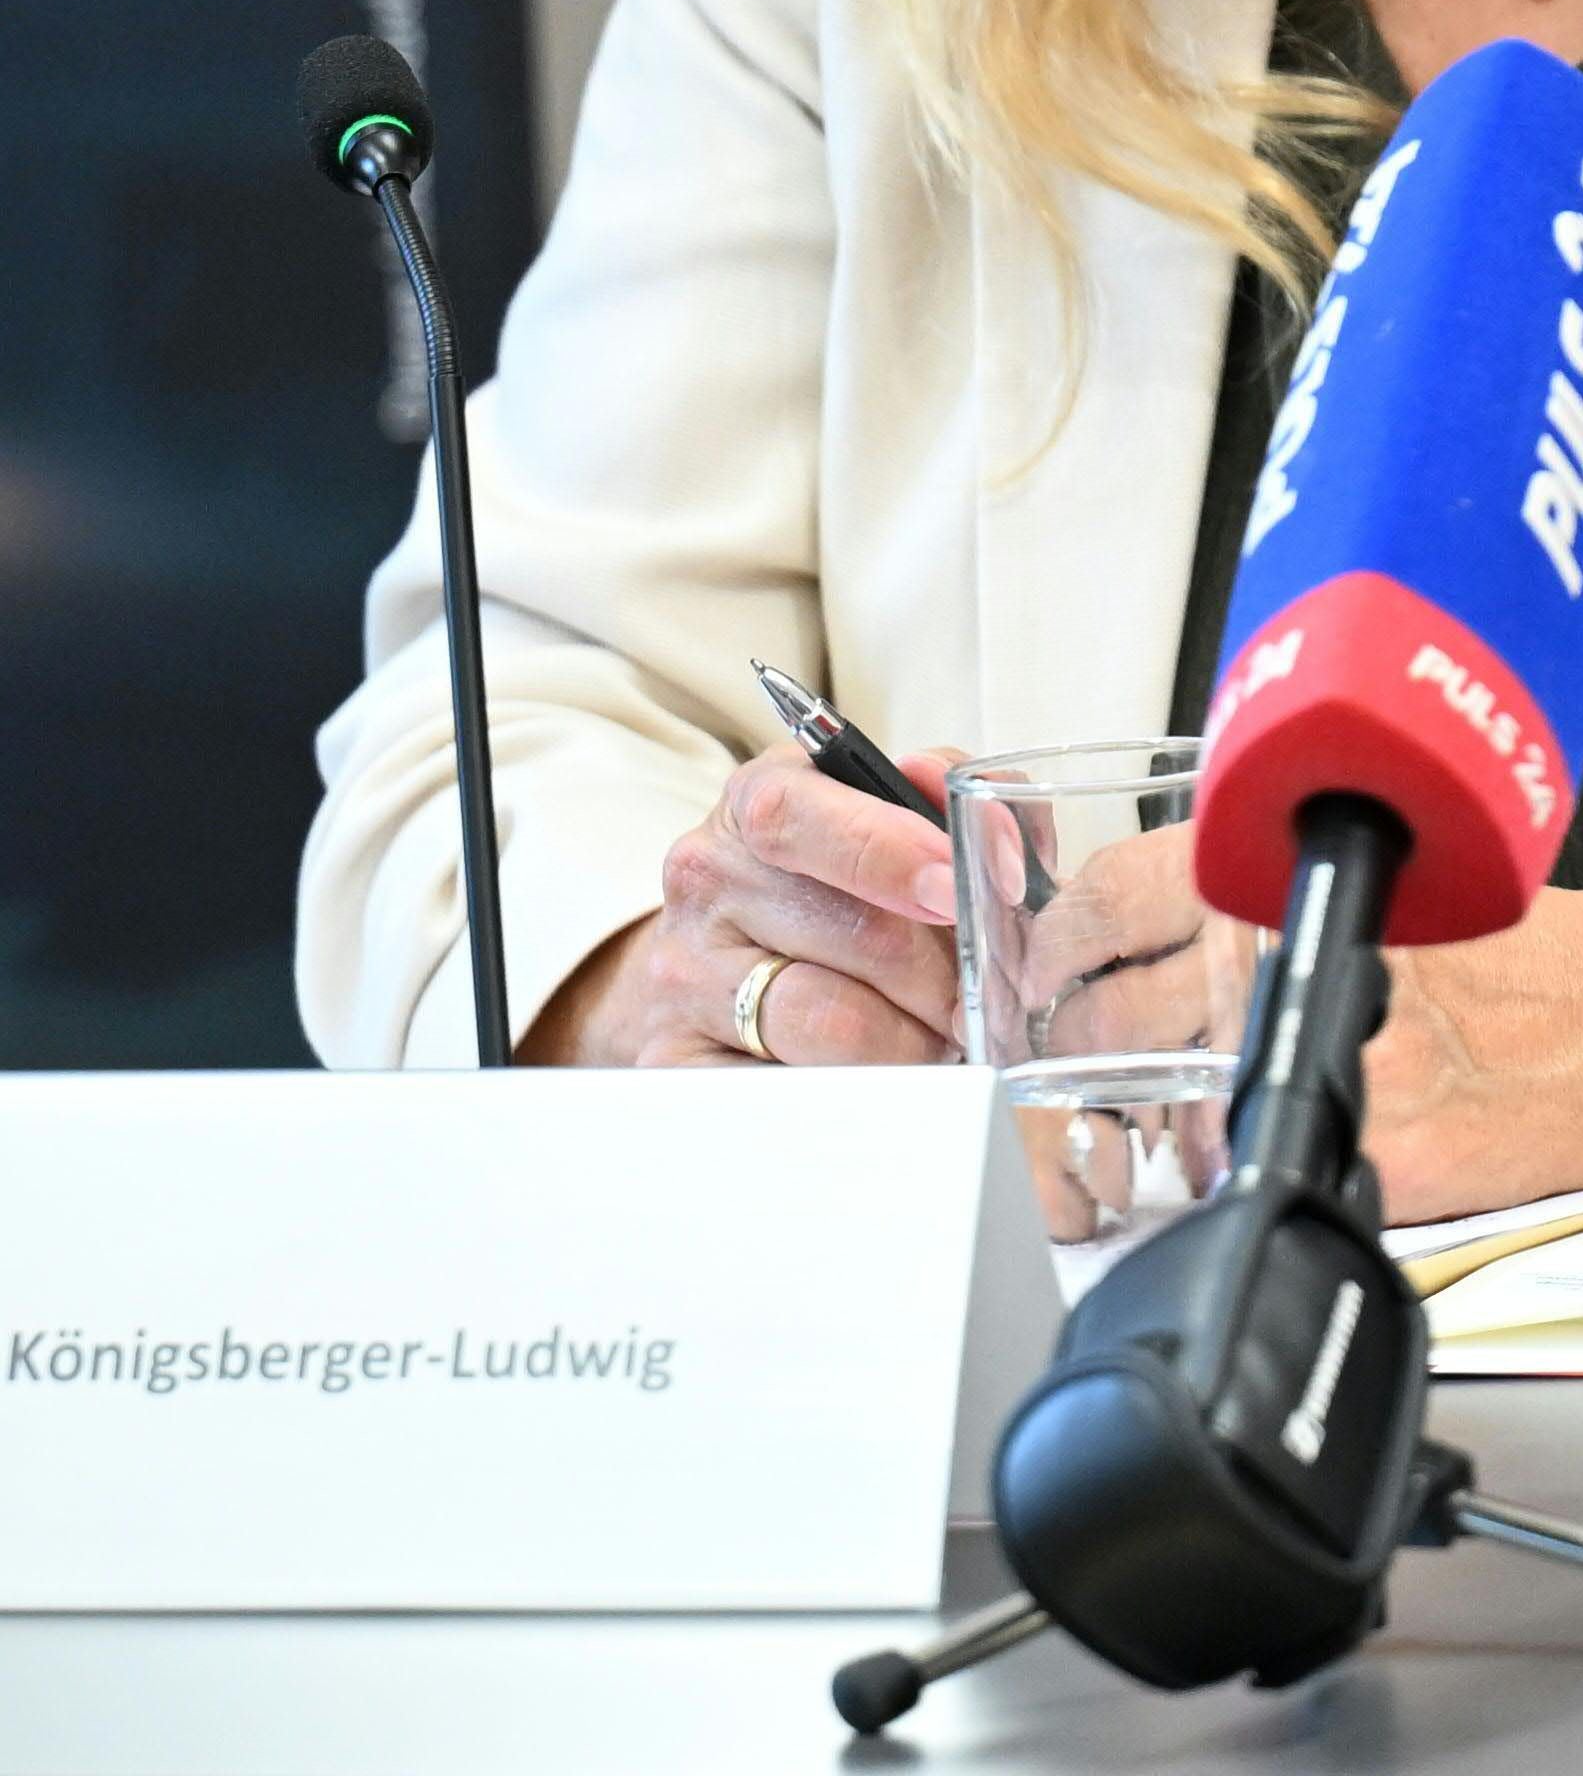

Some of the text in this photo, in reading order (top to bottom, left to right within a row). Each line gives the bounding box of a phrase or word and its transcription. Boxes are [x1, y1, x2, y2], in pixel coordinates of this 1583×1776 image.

[1407, 642, 1557, 830] PULS 24
[6, 1326, 676, 1394] Königsberger-Ludwig
